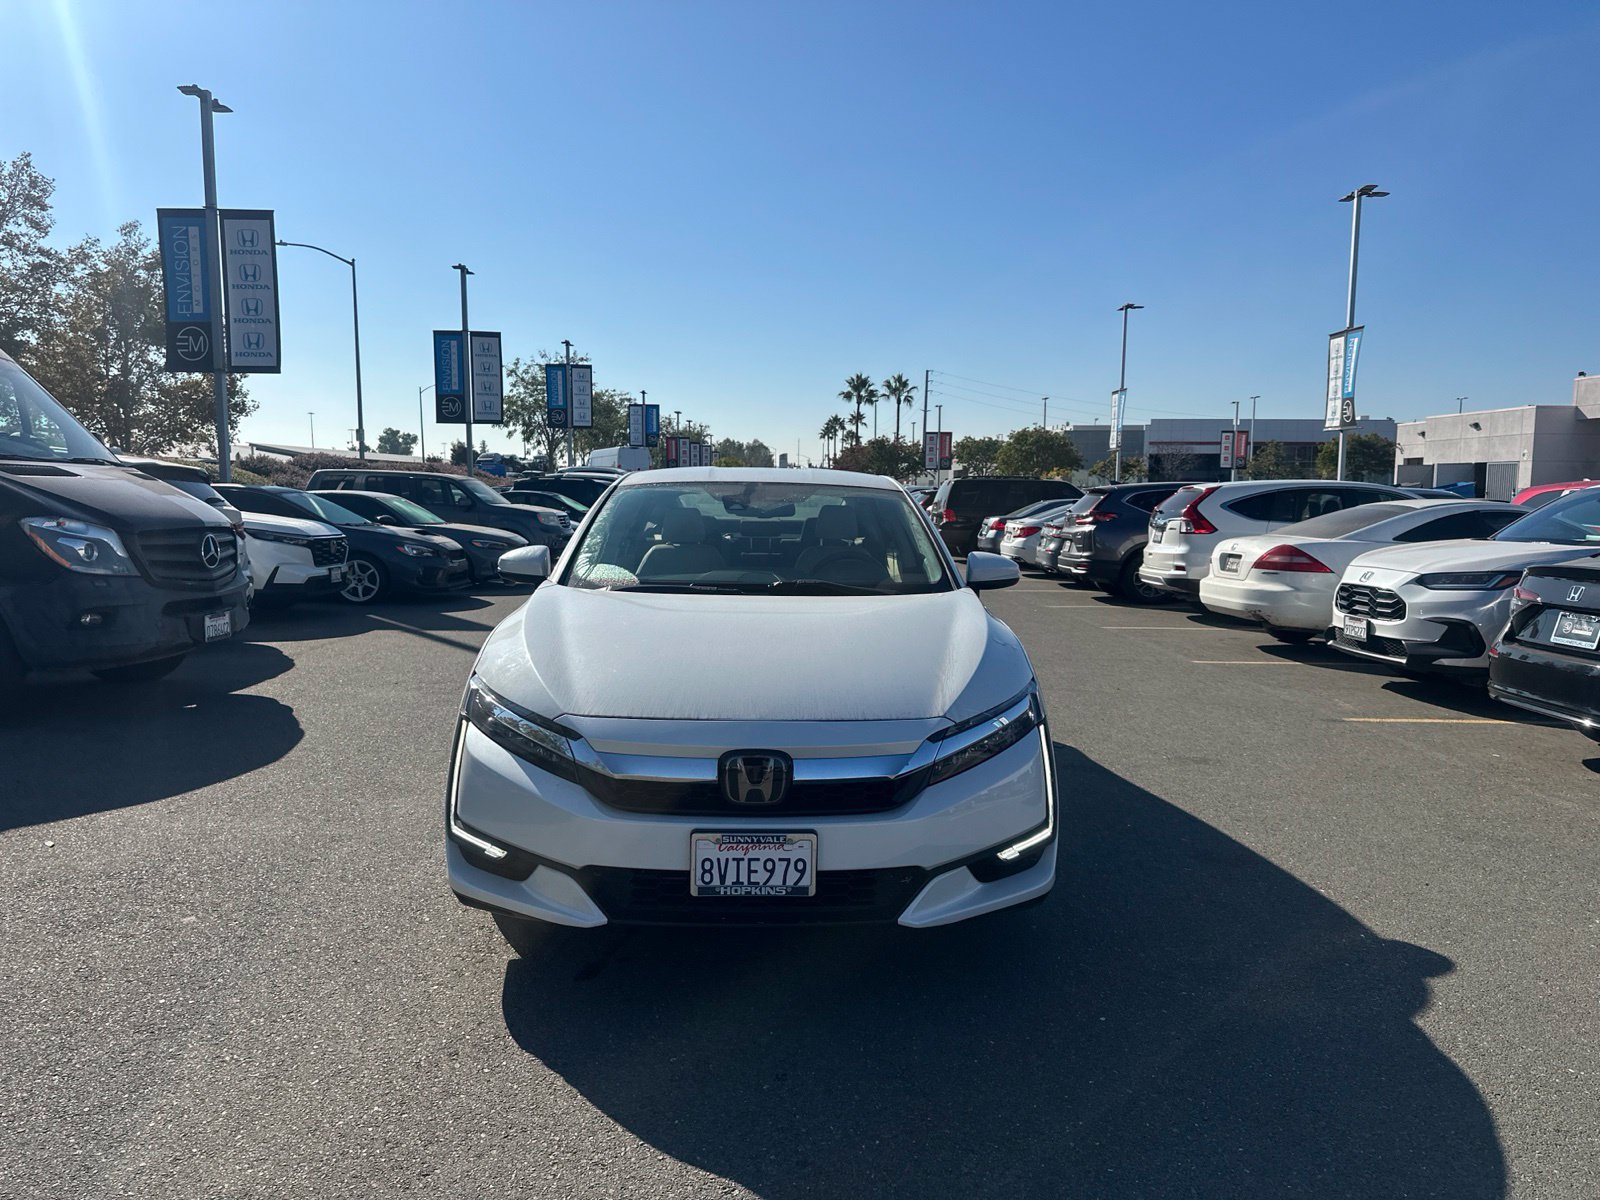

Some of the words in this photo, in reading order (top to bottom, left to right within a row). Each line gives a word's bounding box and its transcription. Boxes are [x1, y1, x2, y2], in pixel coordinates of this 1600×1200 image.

[171, 226, 192, 314] ENVISION
[441, 340, 451, 391] ENVISION
[718, 843, 792, 856] California
[722, 835, 786, 843] SUNNYVALE
[700, 857, 807, 886] 8VIE979
[720, 886, 787, 895] HOPKINS
